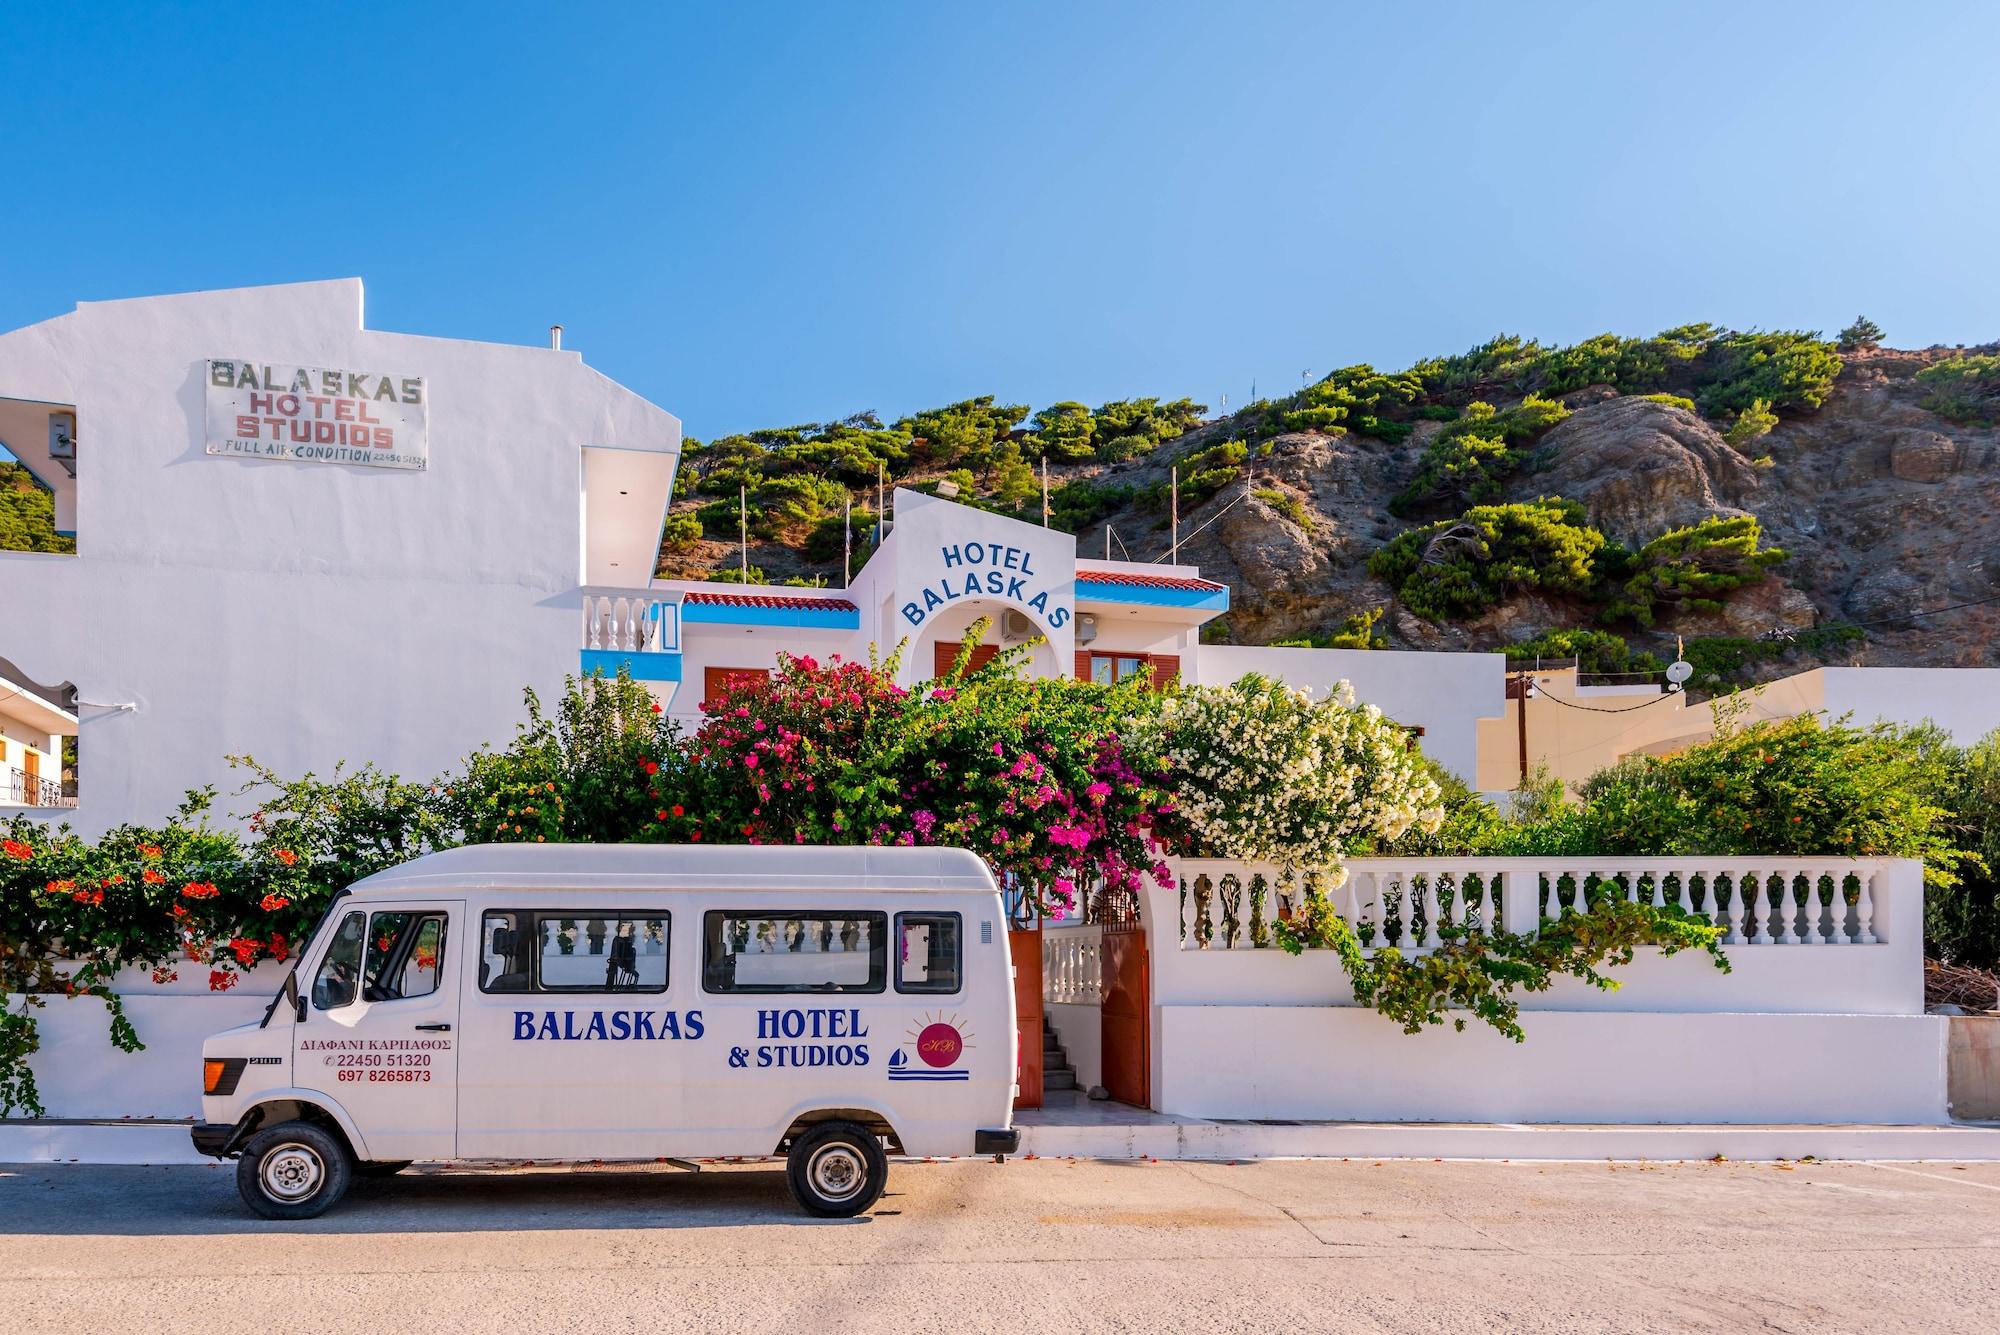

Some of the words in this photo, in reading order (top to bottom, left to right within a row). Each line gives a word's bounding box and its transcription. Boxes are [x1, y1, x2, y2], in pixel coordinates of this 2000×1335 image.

[211, 361, 422, 404] BALASKAS
[250, 392, 380, 424] HOTEL
[236, 416, 394, 449] STUDIOS
[225, 439, 260, 453] FULL
[295, 446, 371, 463] CONDITION
[942, 542, 1034, 576] HOTEL
[901, 571, 1070, 629] BALASKAS
[513, 1011, 704, 1041] BALASKAS
[757, 1009, 869, 1039] HOTEL
[300, 1040, 365, 1051] ΔΙΑΦΑΝΙ
[369, 1040, 452, 1051] ΚΑΡΠΑΘΟΣ
[337, 1054, 381, 1067] 22450
[386, 1054, 431, 1067] 51320
[728, 1047, 749, 1068] &
[757, 1044, 869, 1068] STUDIOS
[338, 1070, 365, 1082] 697
[369, 1070, 431, 1082] 8265873
